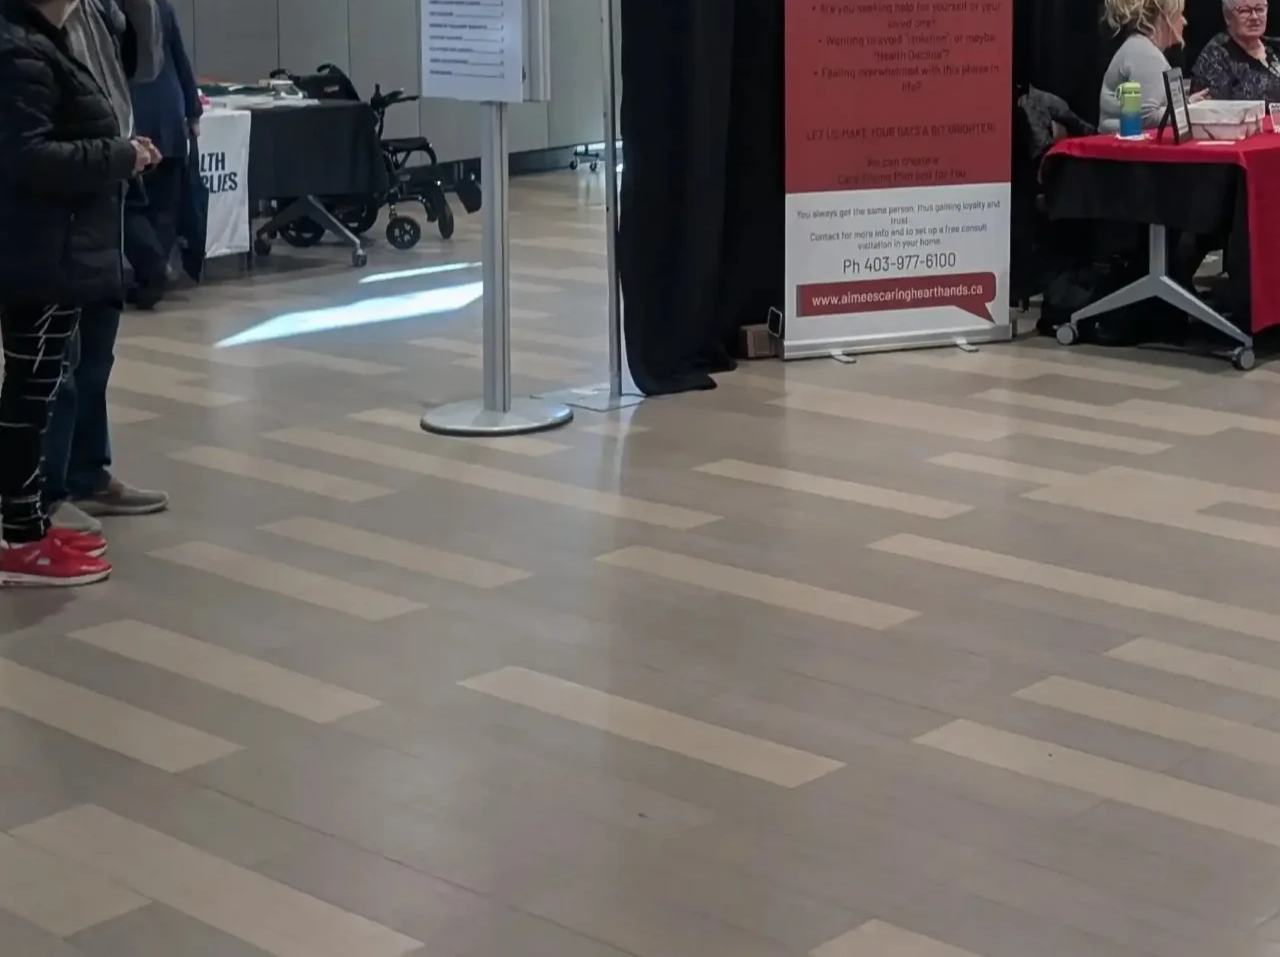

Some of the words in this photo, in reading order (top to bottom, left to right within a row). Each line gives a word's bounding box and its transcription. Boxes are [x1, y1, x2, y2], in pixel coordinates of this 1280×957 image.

[838, 5, 854, 15] you
[895, 2, 914, 13] help
[933, 1, 967, 12] yourself
[821, 67, 855, 79] Feeling
[797, 210, 811, 220] You
[813, 209, 837, 220] always
[854, 208, 865, 216] the
[867, 207, 887, 216] same
[987, 200, 1000, 209] and
[810, 232, 840, 241] Contact
[842, 231, 852, 239] for
[854, 230, 873, 239] more
[875, 229, 889, 238] info
[891, 228, 904, 237] and
[945, 225, 960, 234] free
[962, 223, 987, 233] consult
[902, 239, 918, 249] your
[843, 258, 860, 274] Ph
[864, 252, 956, 272] 403-977-6100
